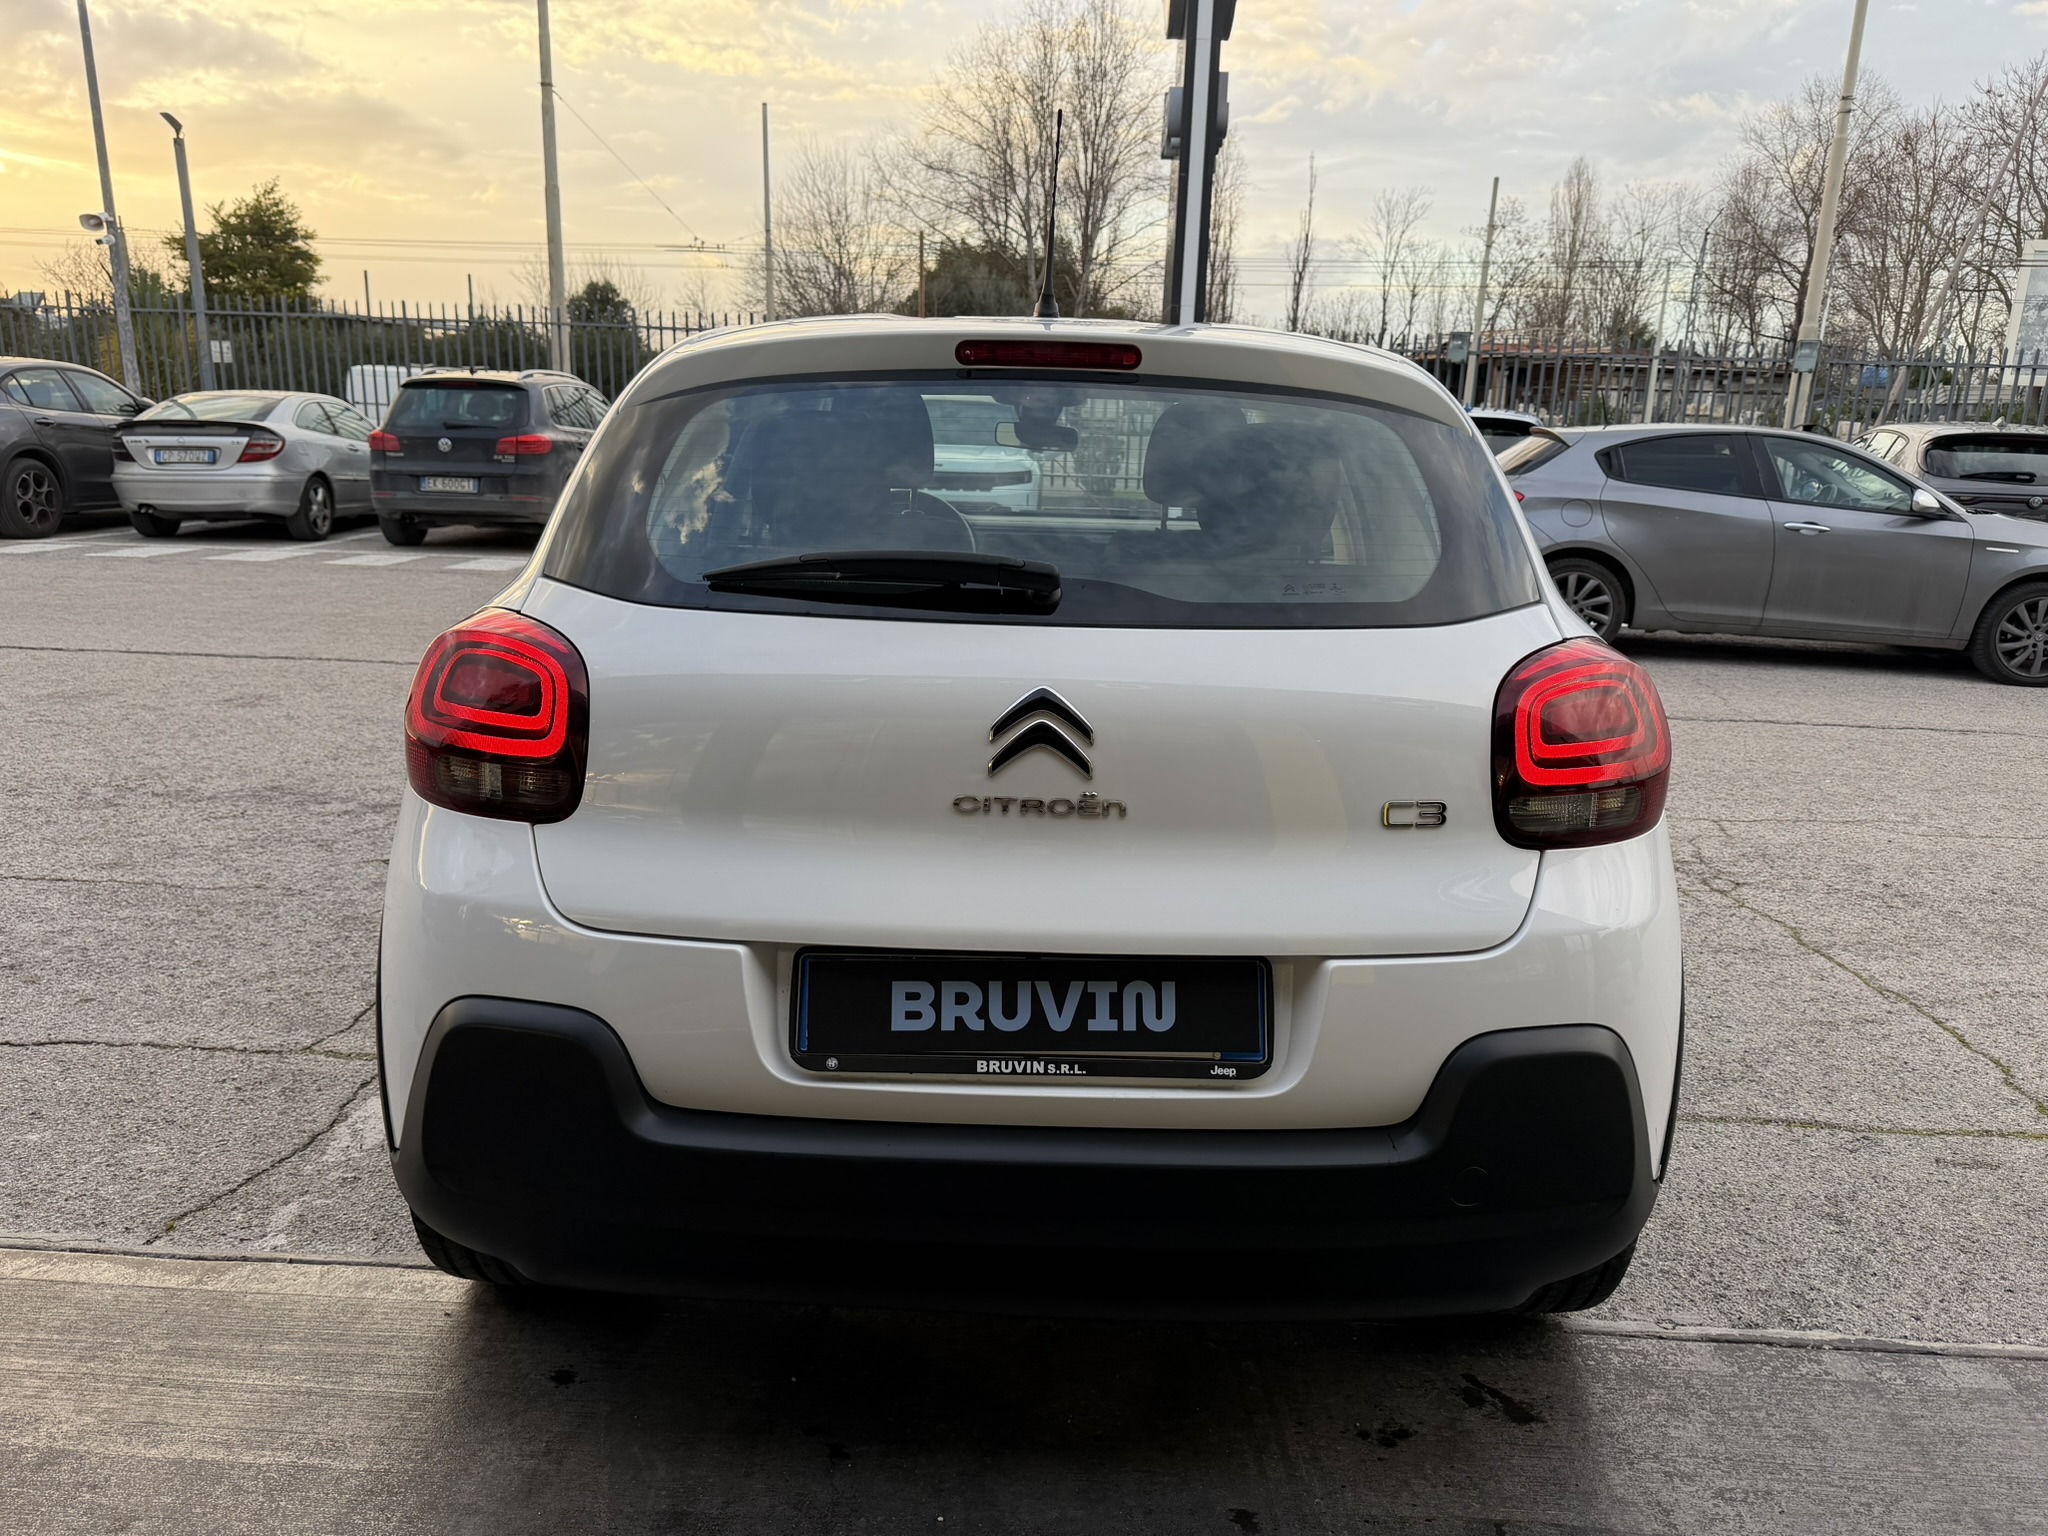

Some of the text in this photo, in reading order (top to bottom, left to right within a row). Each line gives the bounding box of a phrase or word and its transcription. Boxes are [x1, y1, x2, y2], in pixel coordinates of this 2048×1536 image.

[1381, 800, 1447, 828] C3
[976, 1060, 1087, 1074] BRUVIN S.R.L.
[1210, 1065, 1237, 1078] Jeep
